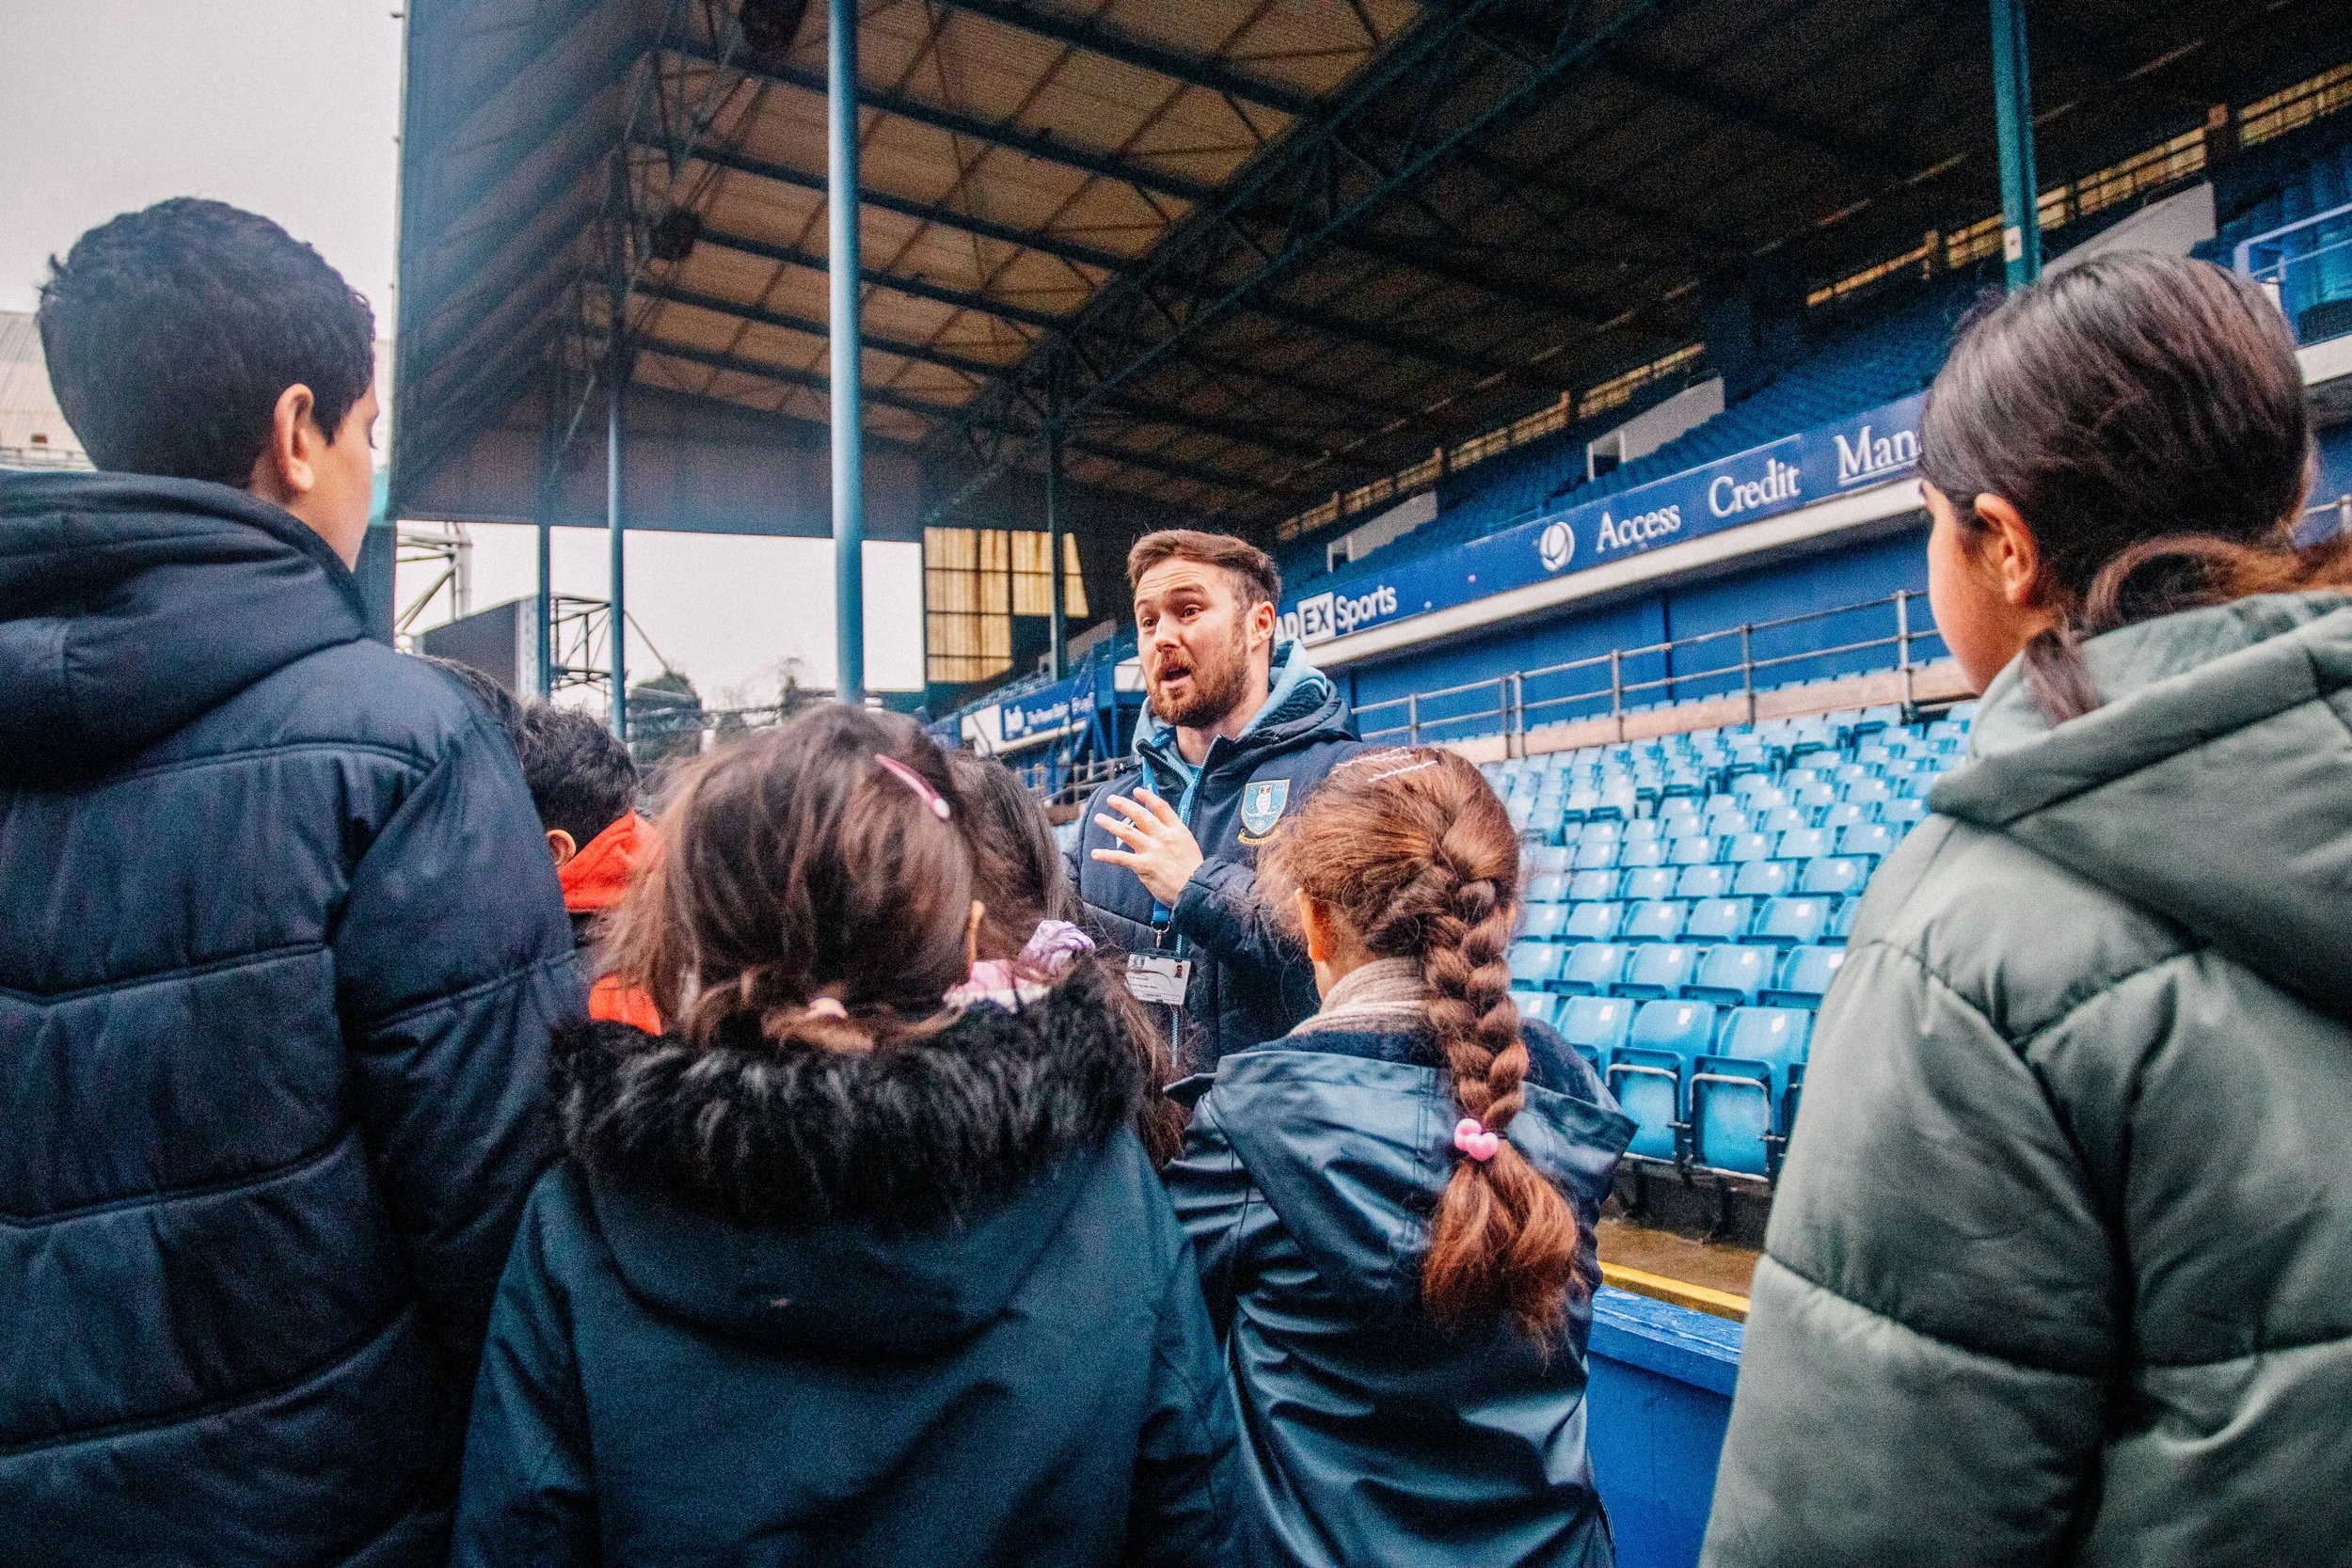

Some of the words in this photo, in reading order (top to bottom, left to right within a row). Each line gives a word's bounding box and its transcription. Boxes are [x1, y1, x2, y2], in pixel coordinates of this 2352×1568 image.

[1596, 504, 1681, 553] Access
[1708, 458, 1802, 517] Credit
[1835, 425, 1922, 480] Man
[1274, 599, 1332, 641] ADEX
[1335, 584, 1397, 632] Sports
